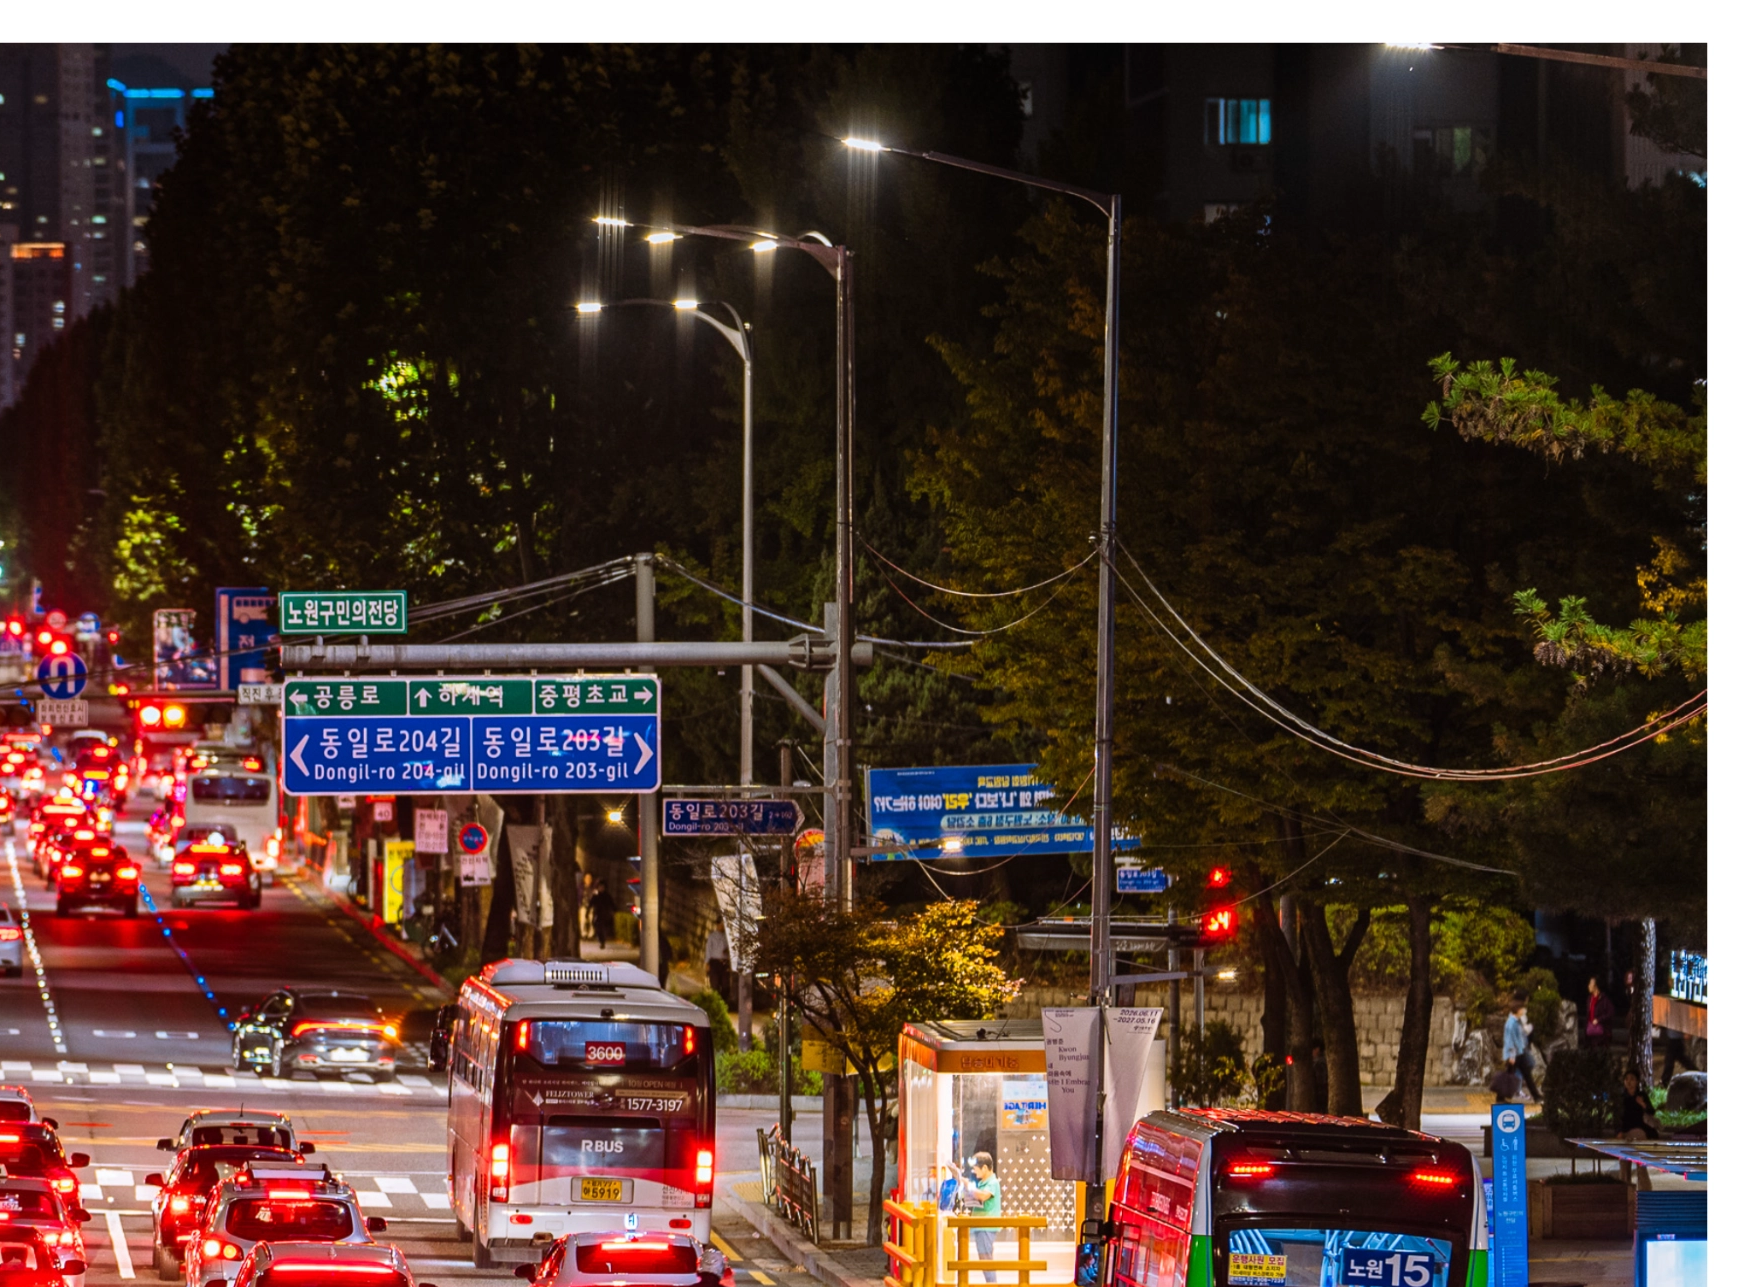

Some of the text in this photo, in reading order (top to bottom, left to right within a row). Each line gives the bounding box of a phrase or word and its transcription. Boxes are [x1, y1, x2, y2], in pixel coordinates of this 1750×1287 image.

[288, 600, 399, 626] 노원구민의전당
[313, 685, 381, 710] 공릉로
[538, 684, 628, 708] 중평초교
[320, 727, 461, 759] 동일로204길
[483, 726, 625, 759] 동일로203길
[314, 763, 466, 782] Dongil-ro 204-gil
[478, 763, 628, 782] Dongil-ro 203-gil
[669, 803, 764, 821] 동일로203길
[669, 822, 711, 832] Dongil-ro
[588, 1046, 623, 1061] 3600
[627, 1098, 683, 1112] 1577-3197
